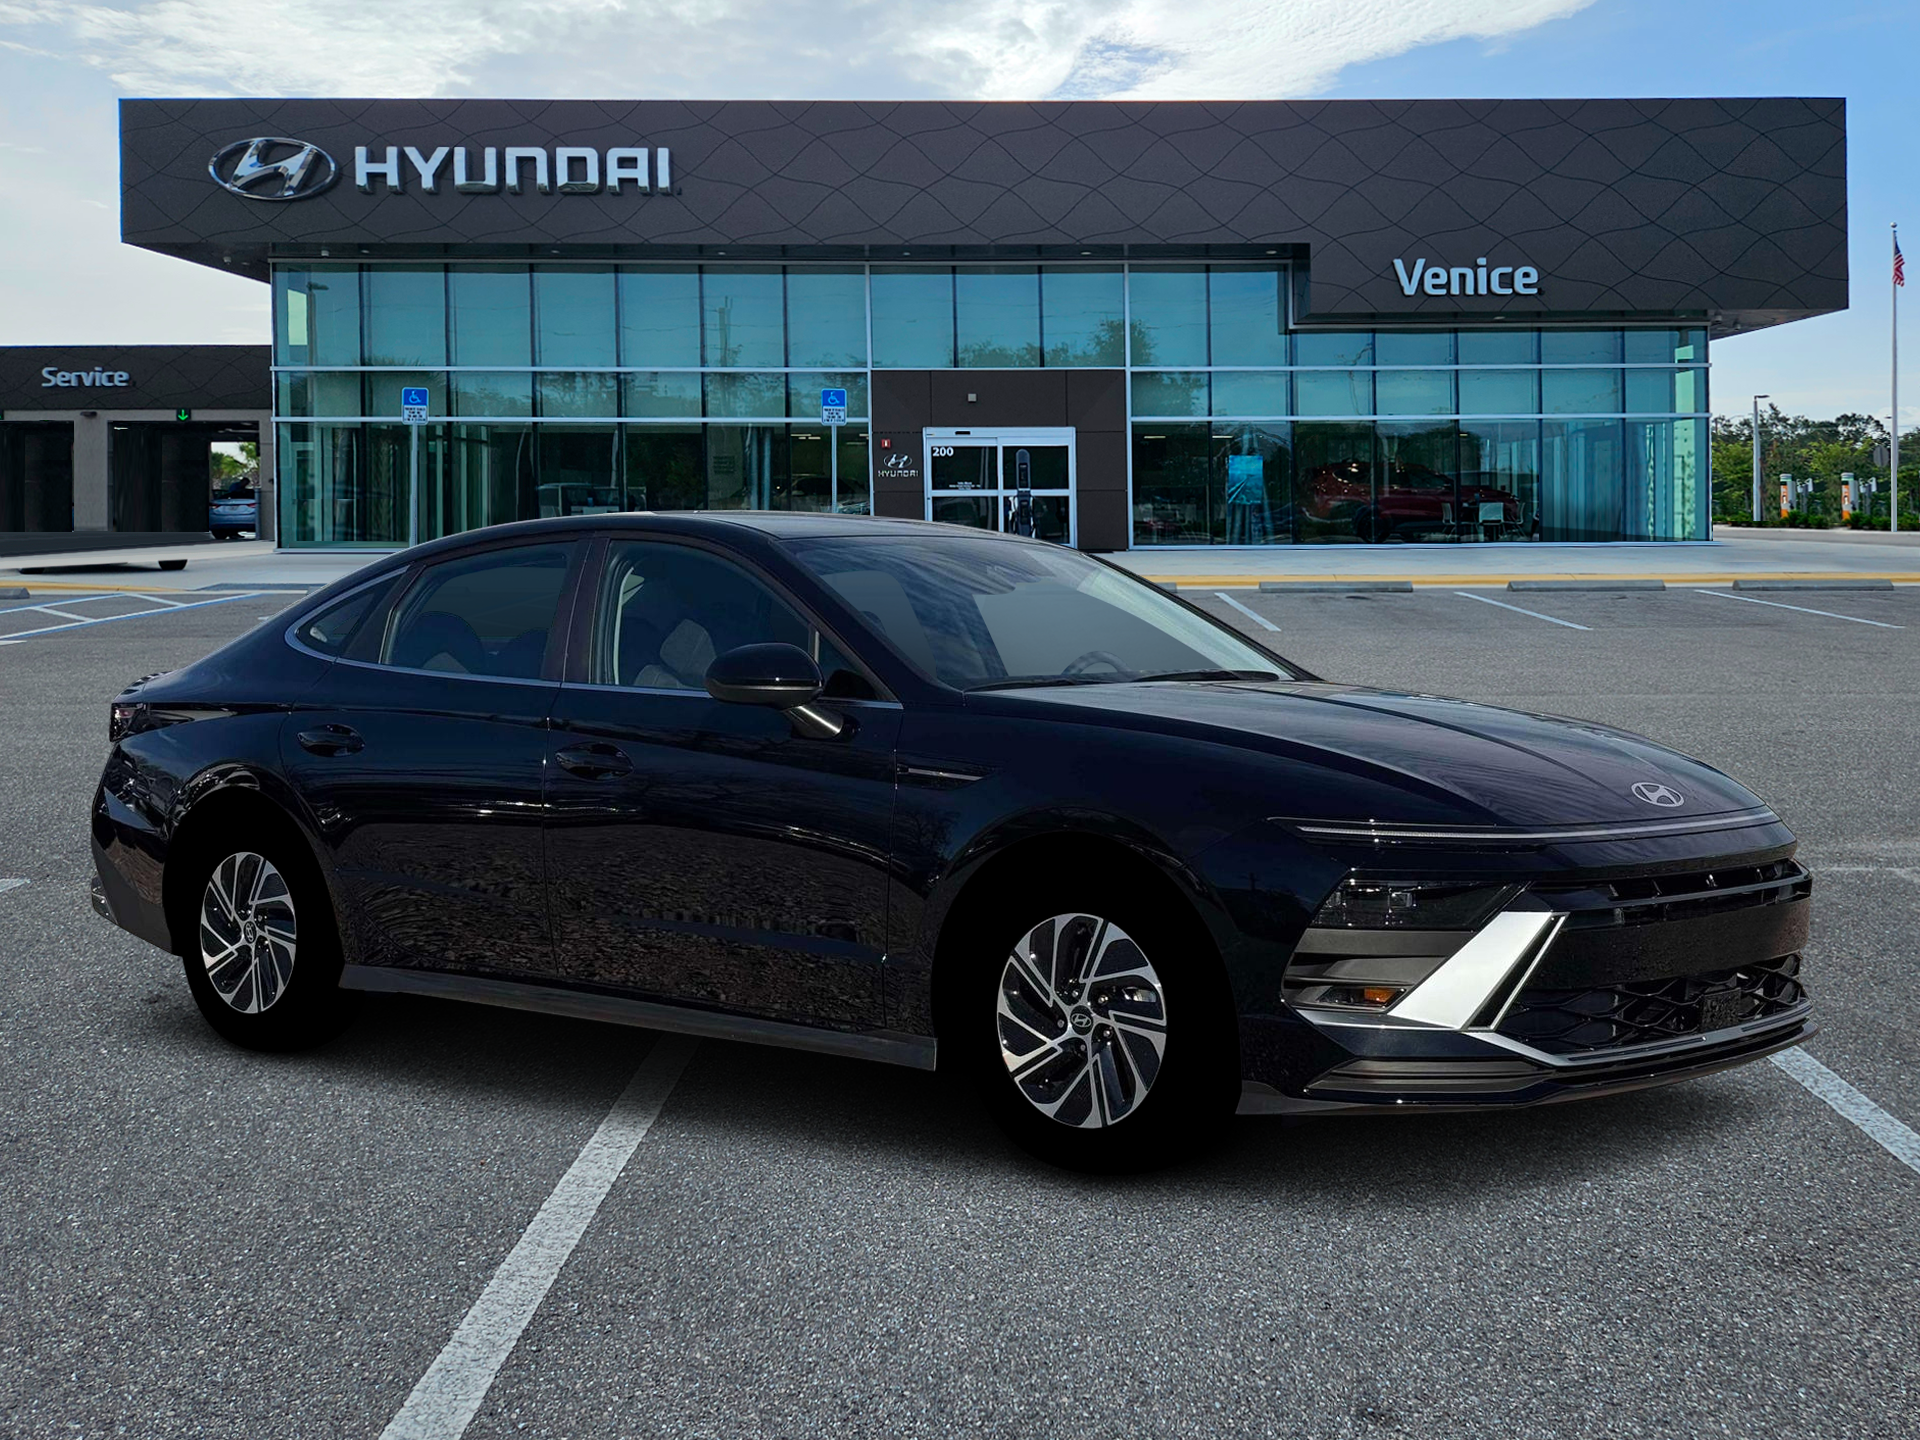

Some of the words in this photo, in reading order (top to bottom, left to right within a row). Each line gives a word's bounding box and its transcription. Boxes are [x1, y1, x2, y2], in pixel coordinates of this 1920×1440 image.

[355, 146, 670, 193] HYUNDAI
[1393, 257, 1538, 295] Venice
[41, 366, 130, 387] Service
[932, 446, 954, 457] 200
[877, 470, 919, 478] HYUNDAI
